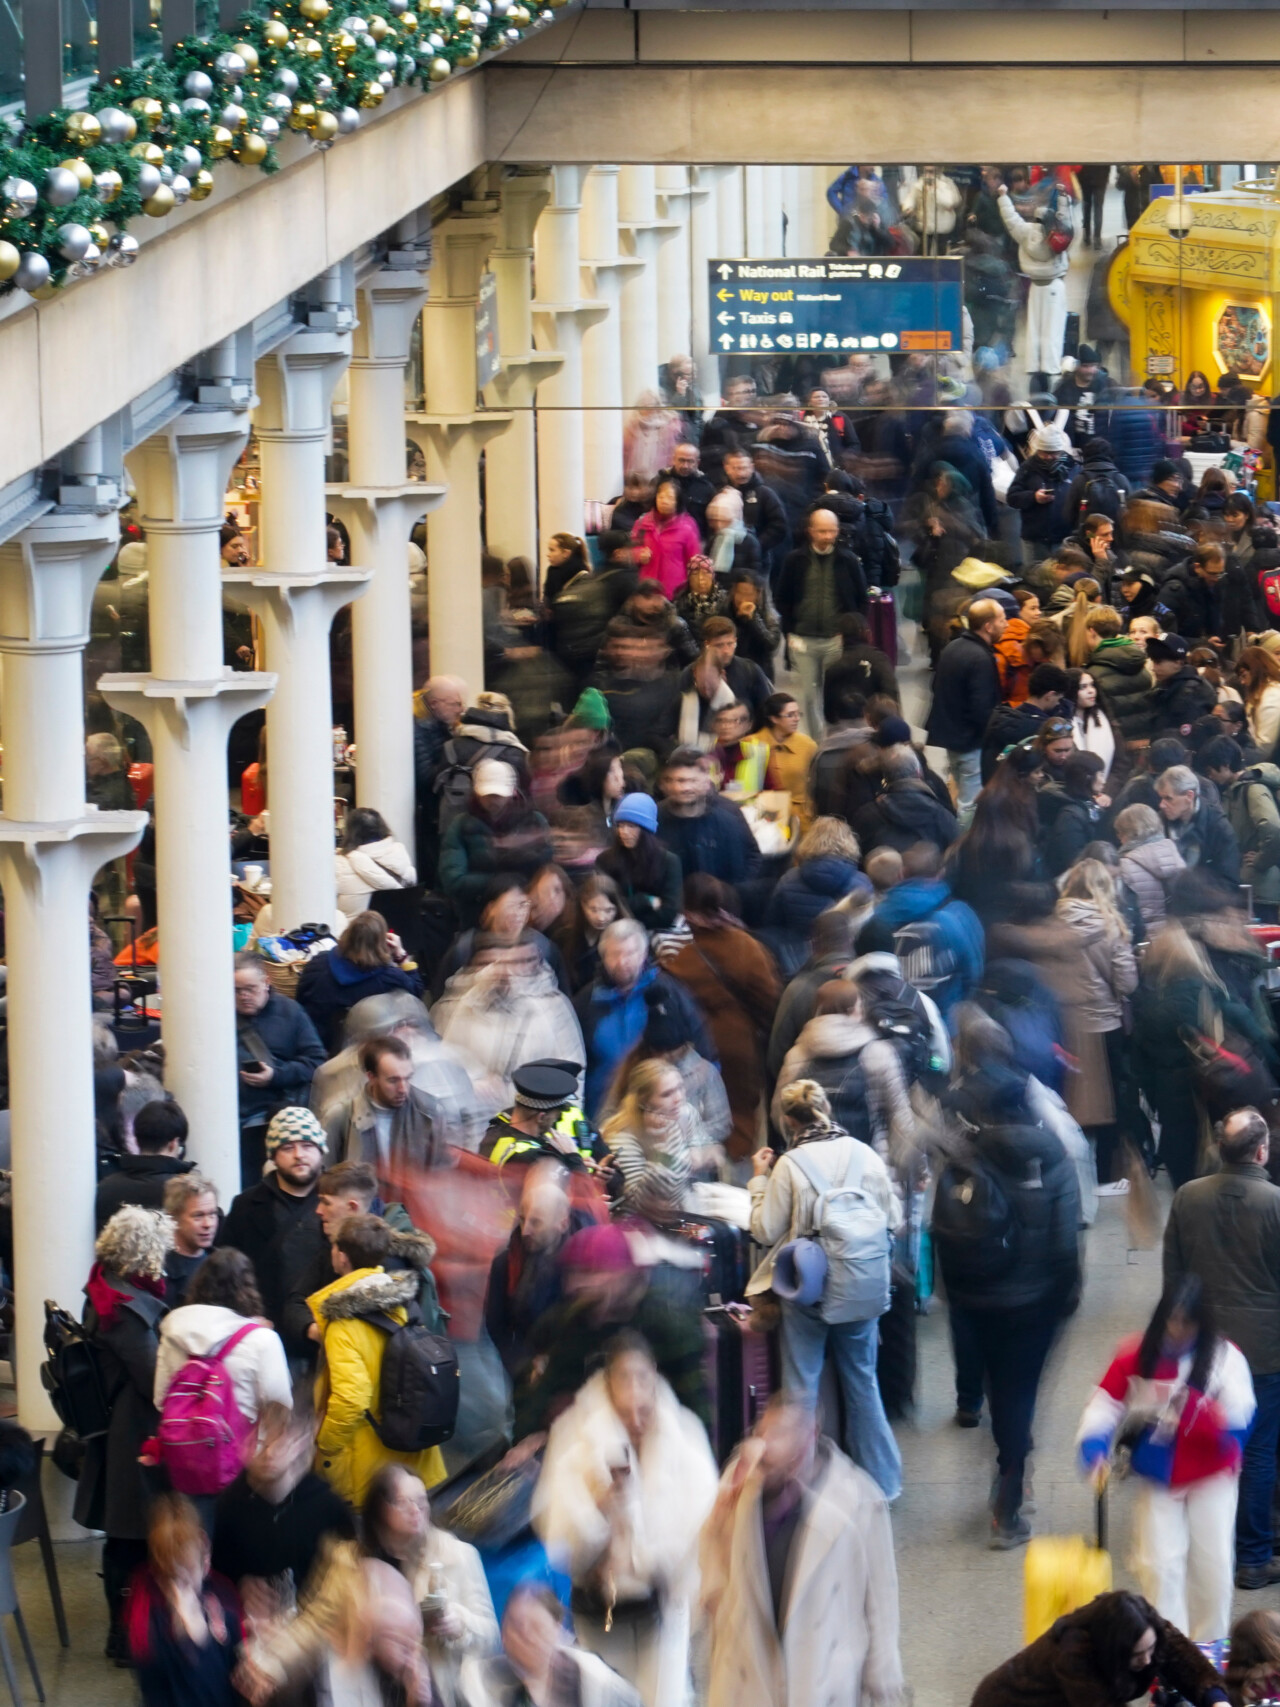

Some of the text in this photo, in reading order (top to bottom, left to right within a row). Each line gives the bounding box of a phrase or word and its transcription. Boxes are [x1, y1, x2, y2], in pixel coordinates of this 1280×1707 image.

[738, 264, 827, 278] National Rail
[739, 289, 794, 304] Way out
[739, 311, 777, 324] Taxis
